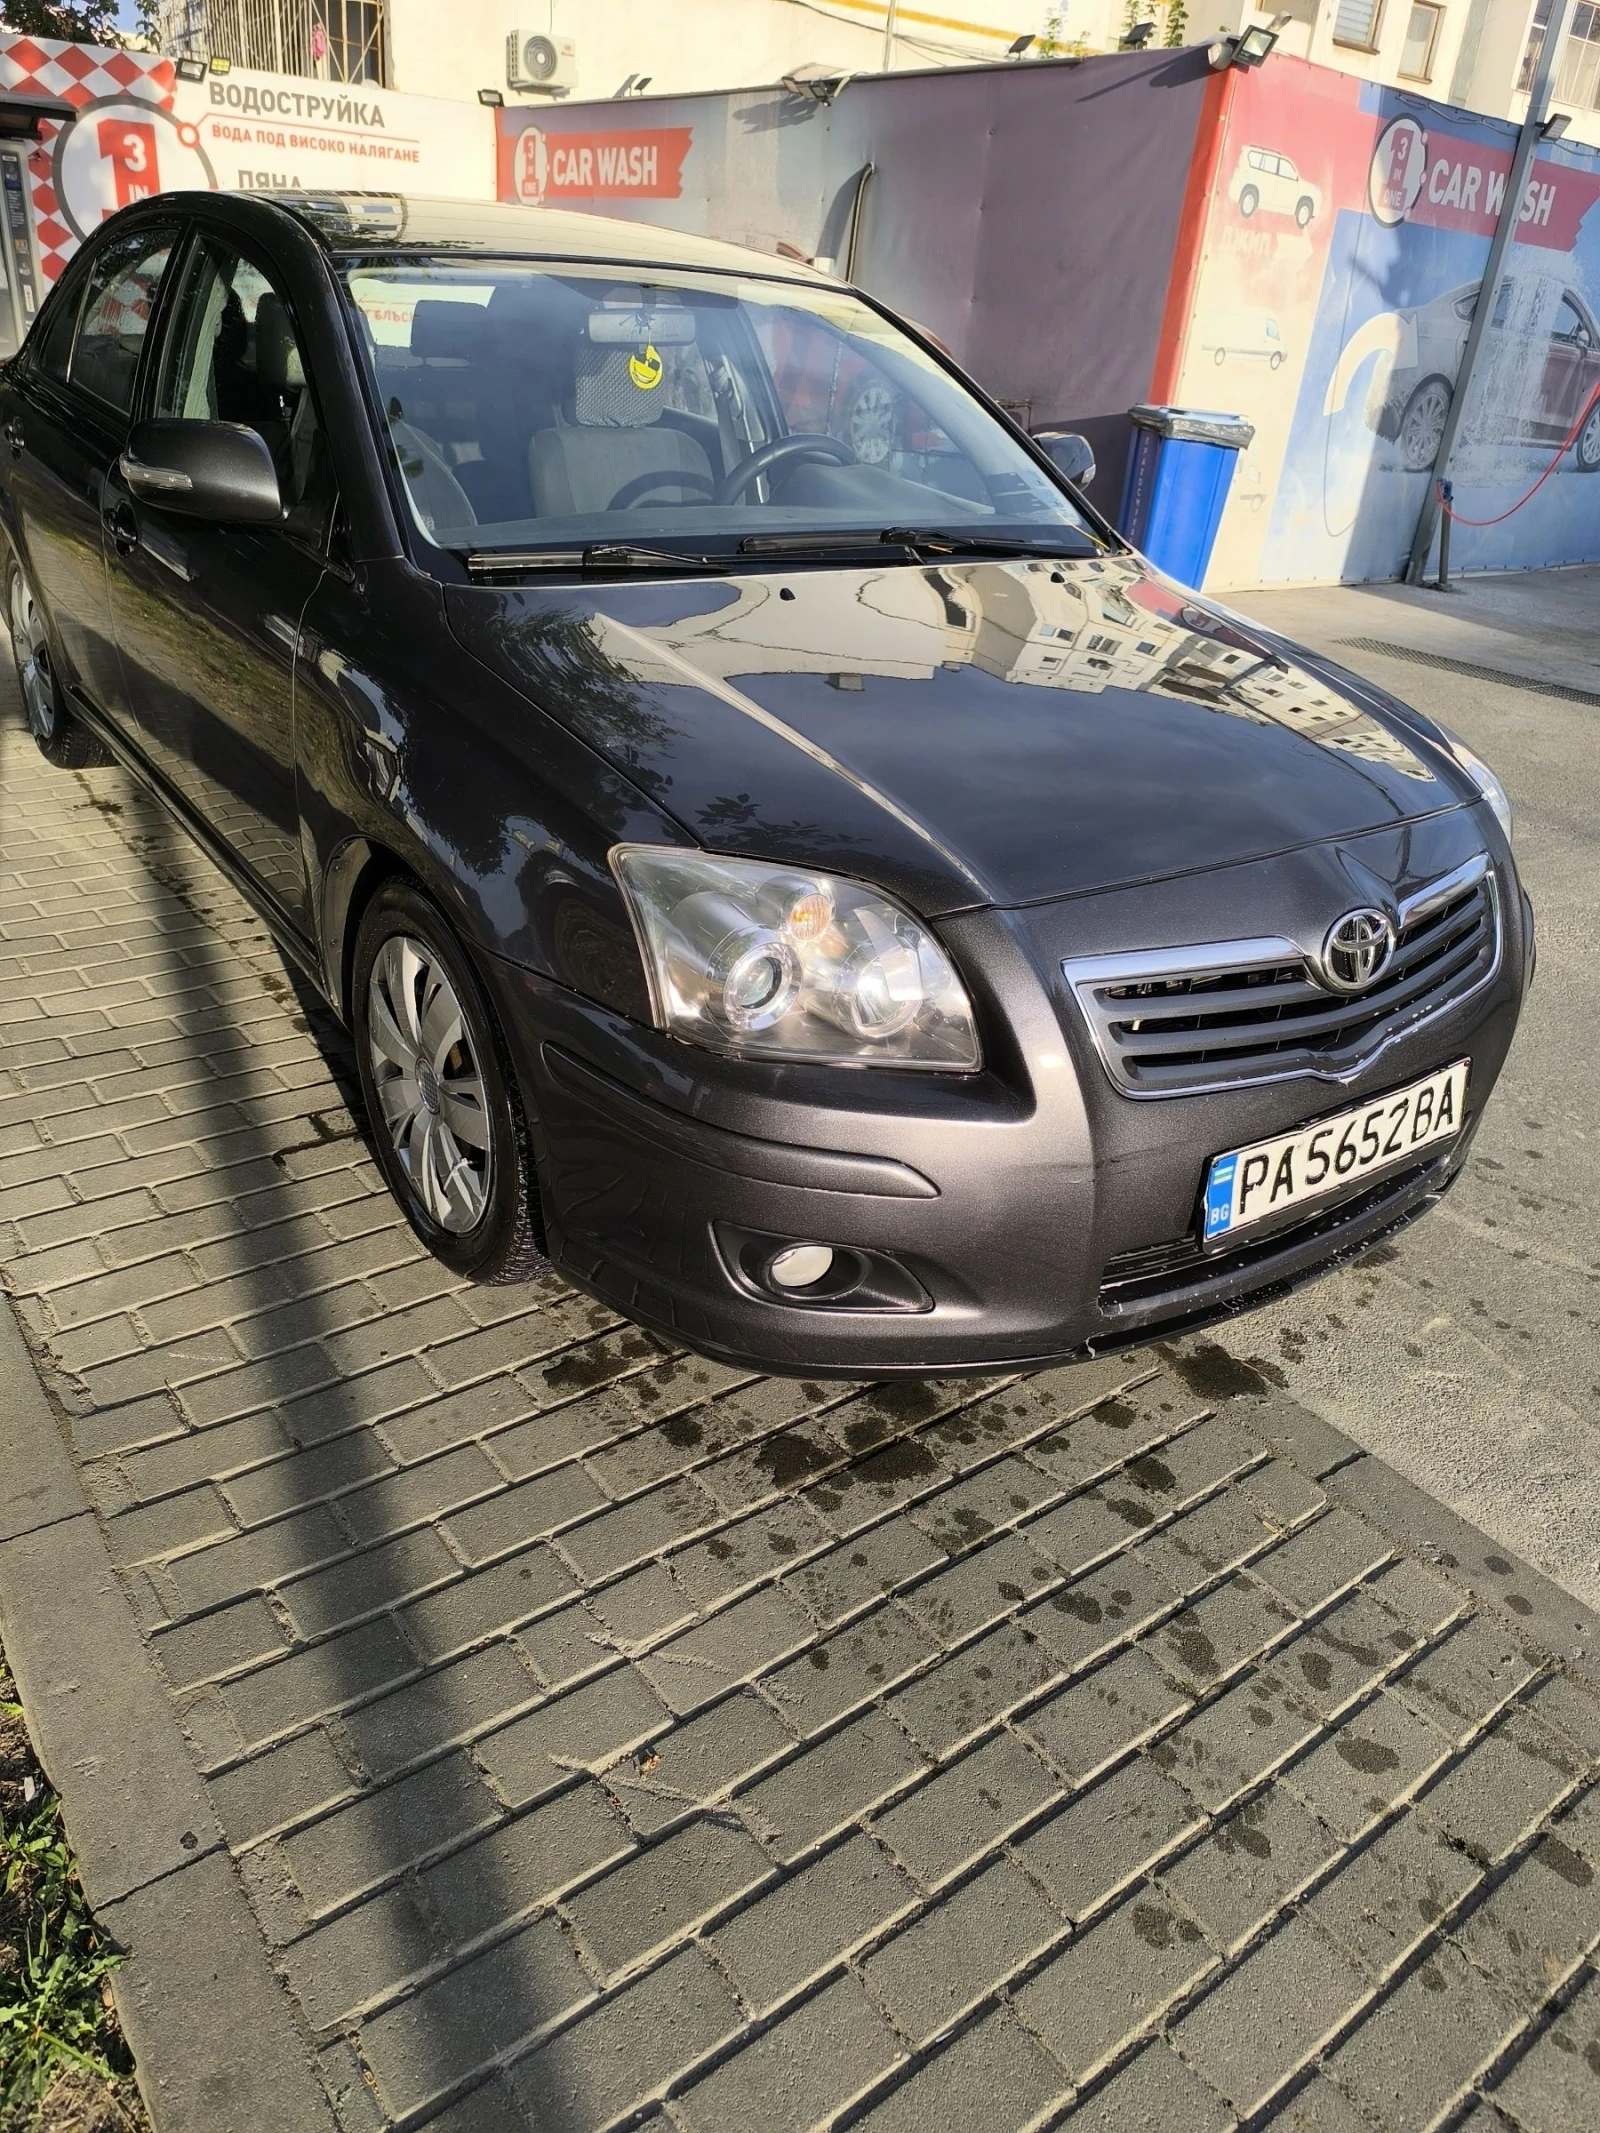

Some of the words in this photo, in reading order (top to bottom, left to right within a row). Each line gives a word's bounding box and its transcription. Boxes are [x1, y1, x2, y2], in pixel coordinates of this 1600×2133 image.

[209, 81, 386, 128] ВОДОСТРУЙКА
[123, 134, 147, 172] 3
[212, 124, 252, 143] ВОДА
[256, 130, 286, 148] ПОД
[289, 134, 345, 154] ВИСОКО
[349, 141, 420, 163] НАЛЯГАНЕ
[1397, 136, 1408, 161] 3
[552, 148, 593, 186] CAR
[597, 146, 657, 186] WASH
[1383, 187, 1402, 206] ONE
[1428, 158, 1482, 212] CAR
[1484, 170, 1557, 226] WSH
[1210, 1203, 1230, 1226] BG
